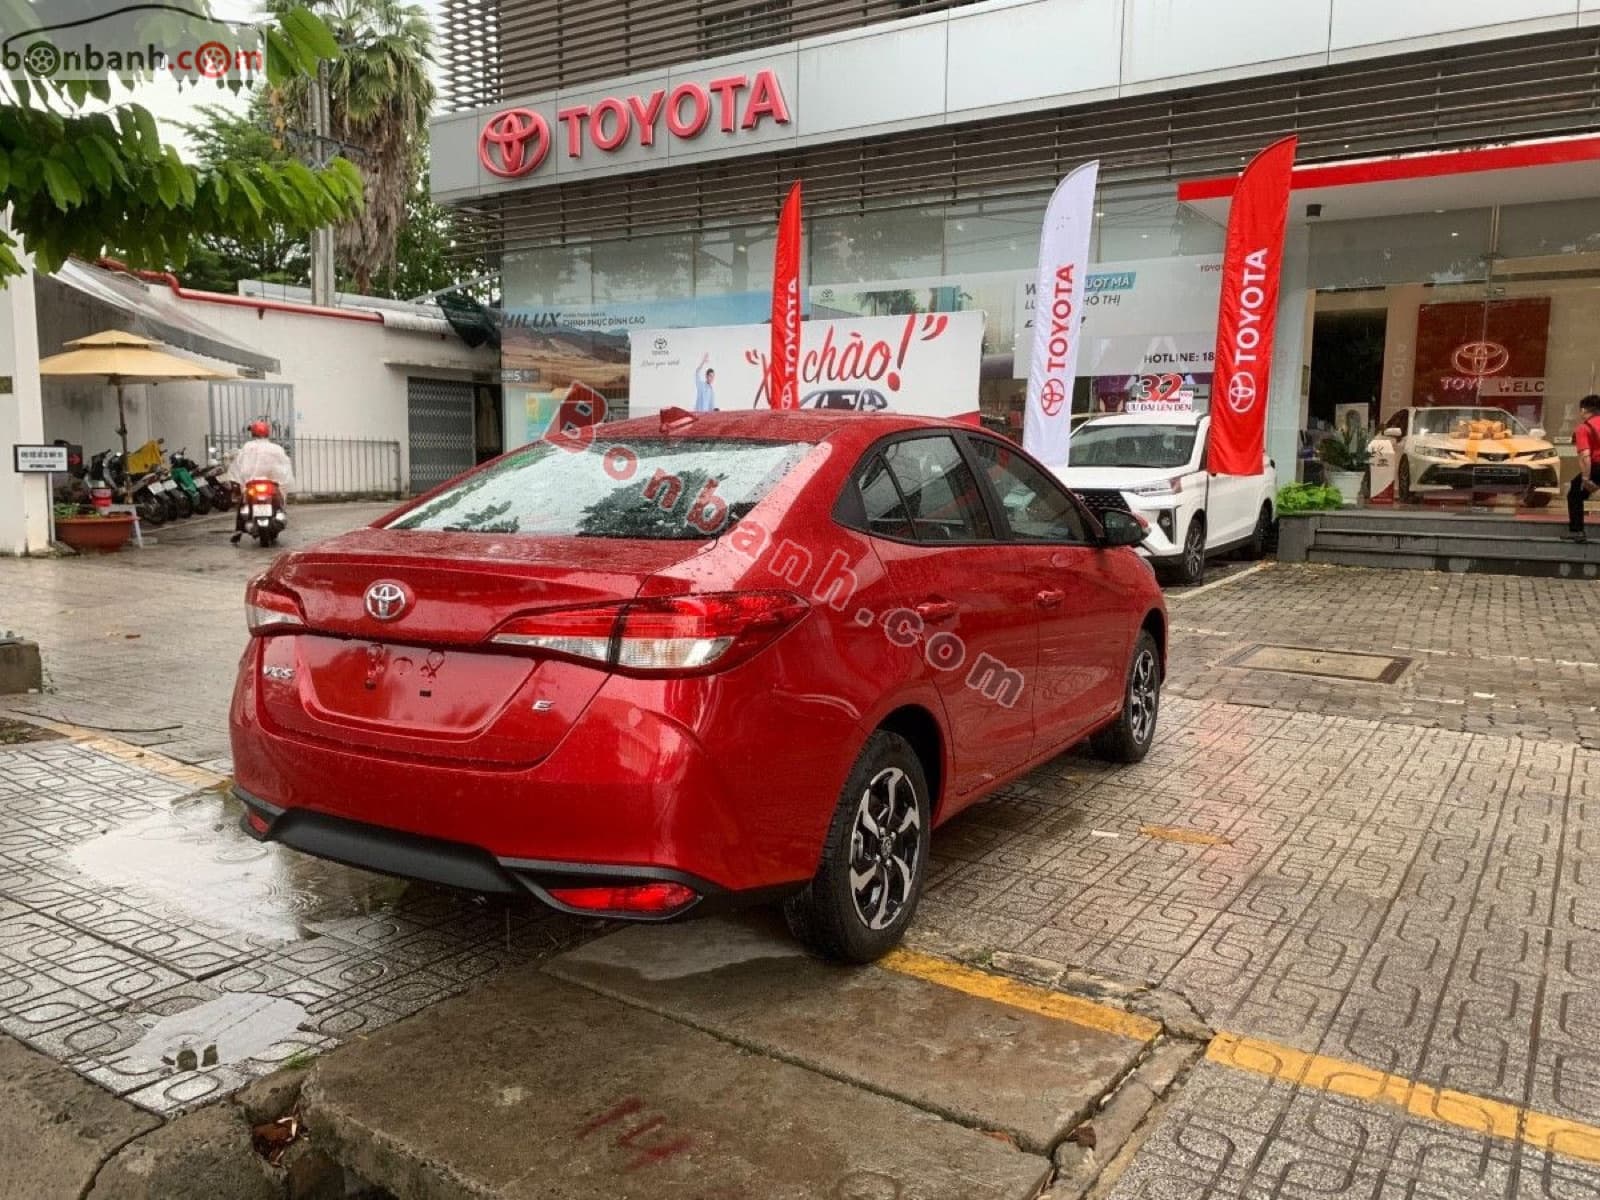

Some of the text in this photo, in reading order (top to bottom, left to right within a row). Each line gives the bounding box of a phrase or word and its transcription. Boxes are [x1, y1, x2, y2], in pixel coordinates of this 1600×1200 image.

[558, 68, 790, 159] TOYOTA
[500, 312, 560, 328] HILUX
[784, 276, 798, 377] TOYOTA
[1047, 263, 1075, 372] TOYOTA
[1234, 247, 1268, 365] TOYOTA
[1138, 371, 1184, 402] 32
[1144, 352, 1199, 363] HOTLINE:
